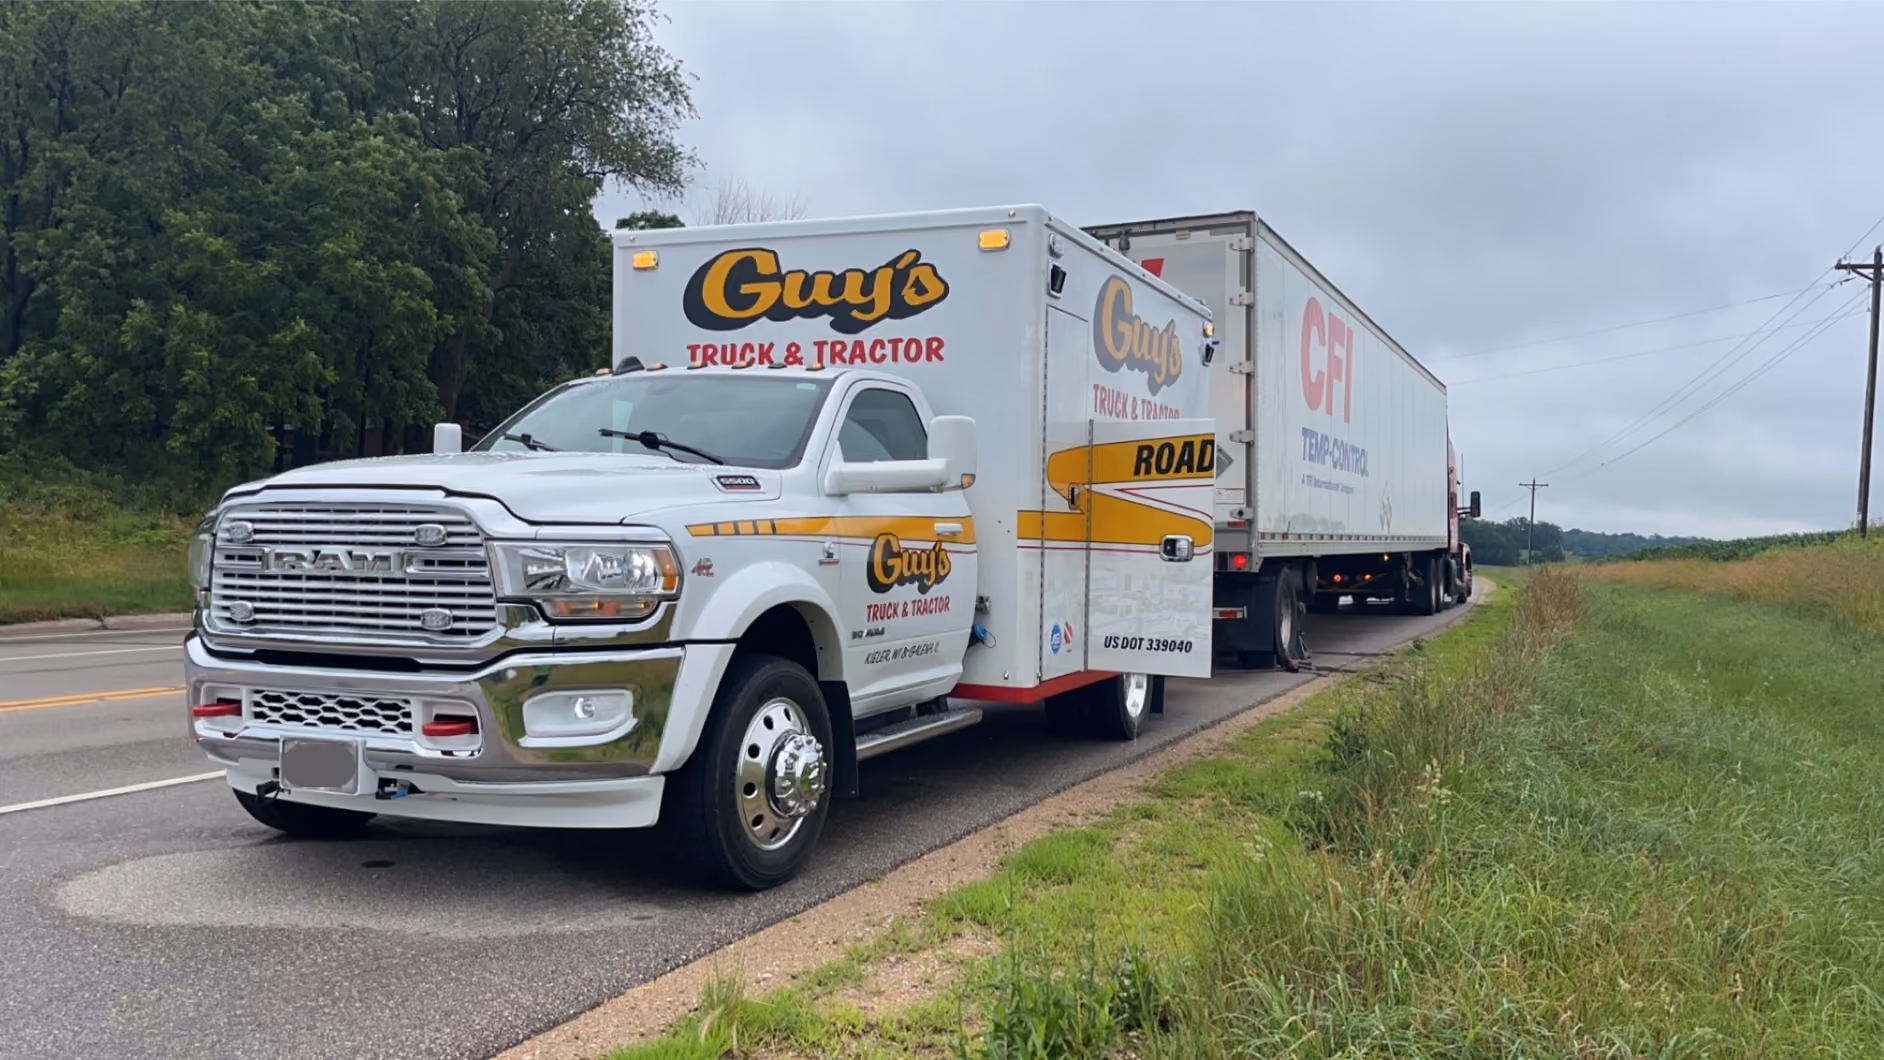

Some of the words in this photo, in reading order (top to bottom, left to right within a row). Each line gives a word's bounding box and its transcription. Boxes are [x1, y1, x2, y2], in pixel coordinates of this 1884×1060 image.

[690, 247, 948, 328] Guy's
[1097, 275, 1182, 391] Guy's
[687, 342, 775, 366] TRUCK
[784, 342, 804, 366] &
[813, 337, 945, 365] TRACTOR
[1301, 297, 1354, 424] CFI
[1093, 384, 1128, 420] TRUCK
[1131, 396, 1138, 420] &
[1133, 438, 1214, 477] ROAD
[720, 477, 755, 485] 5500
[270, 546, 399, 575] RAM
[870, 533, 951, 590] Guy's
[867, 602, 899, 622] TRUCK
[901, 601, 908, 618] &
[911, 595, 950, 616] TRACTOR
[1104, 636, 1120, 649] US
[1121, 637, 1145, 650] DOT
[1145, 638, 1193, 653] 339040
